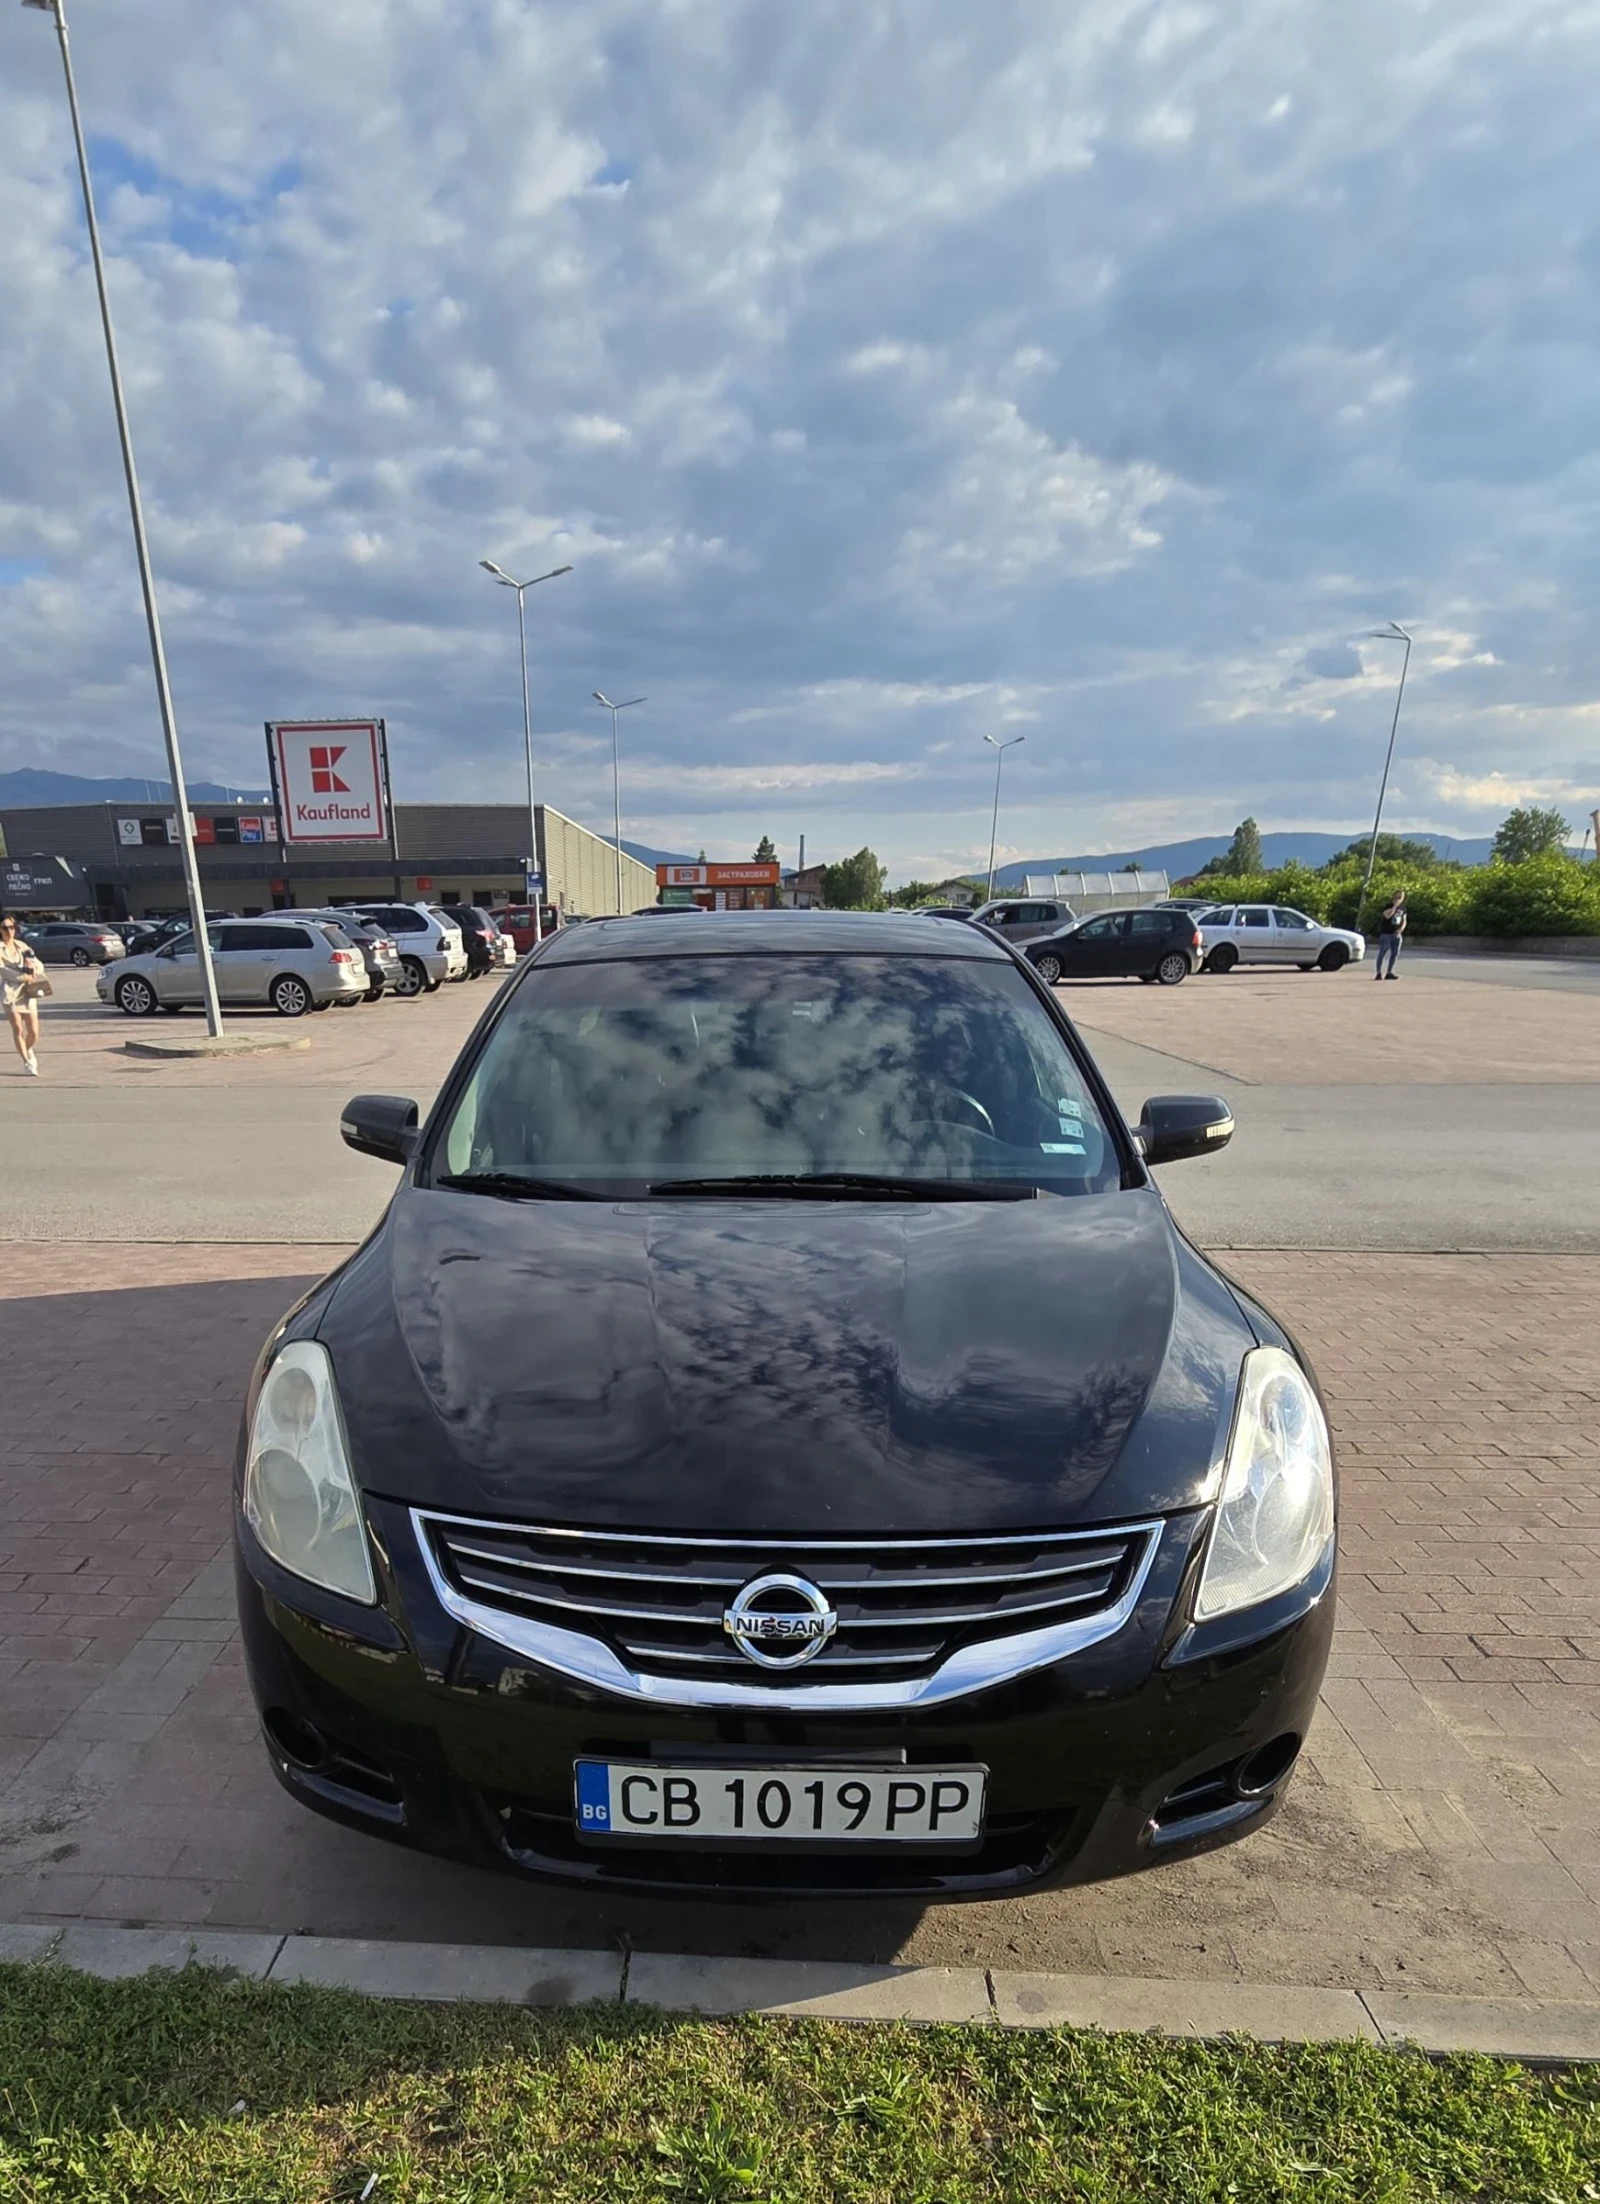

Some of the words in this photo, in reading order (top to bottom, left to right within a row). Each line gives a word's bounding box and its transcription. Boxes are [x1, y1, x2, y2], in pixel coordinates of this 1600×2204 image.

[297, 802, 371, 820] Kaufland
[717, 870, 770, 879] ЗАСТРАХОВКИ
[736, 1617, 825, 1634] NISSAN
[582, 1803, 608, 1820] BG
[621, 1775, 701, 1826] CB
[724, 1778, 872, 1831] 1019
[885, 1781, 969, 1831] PP
